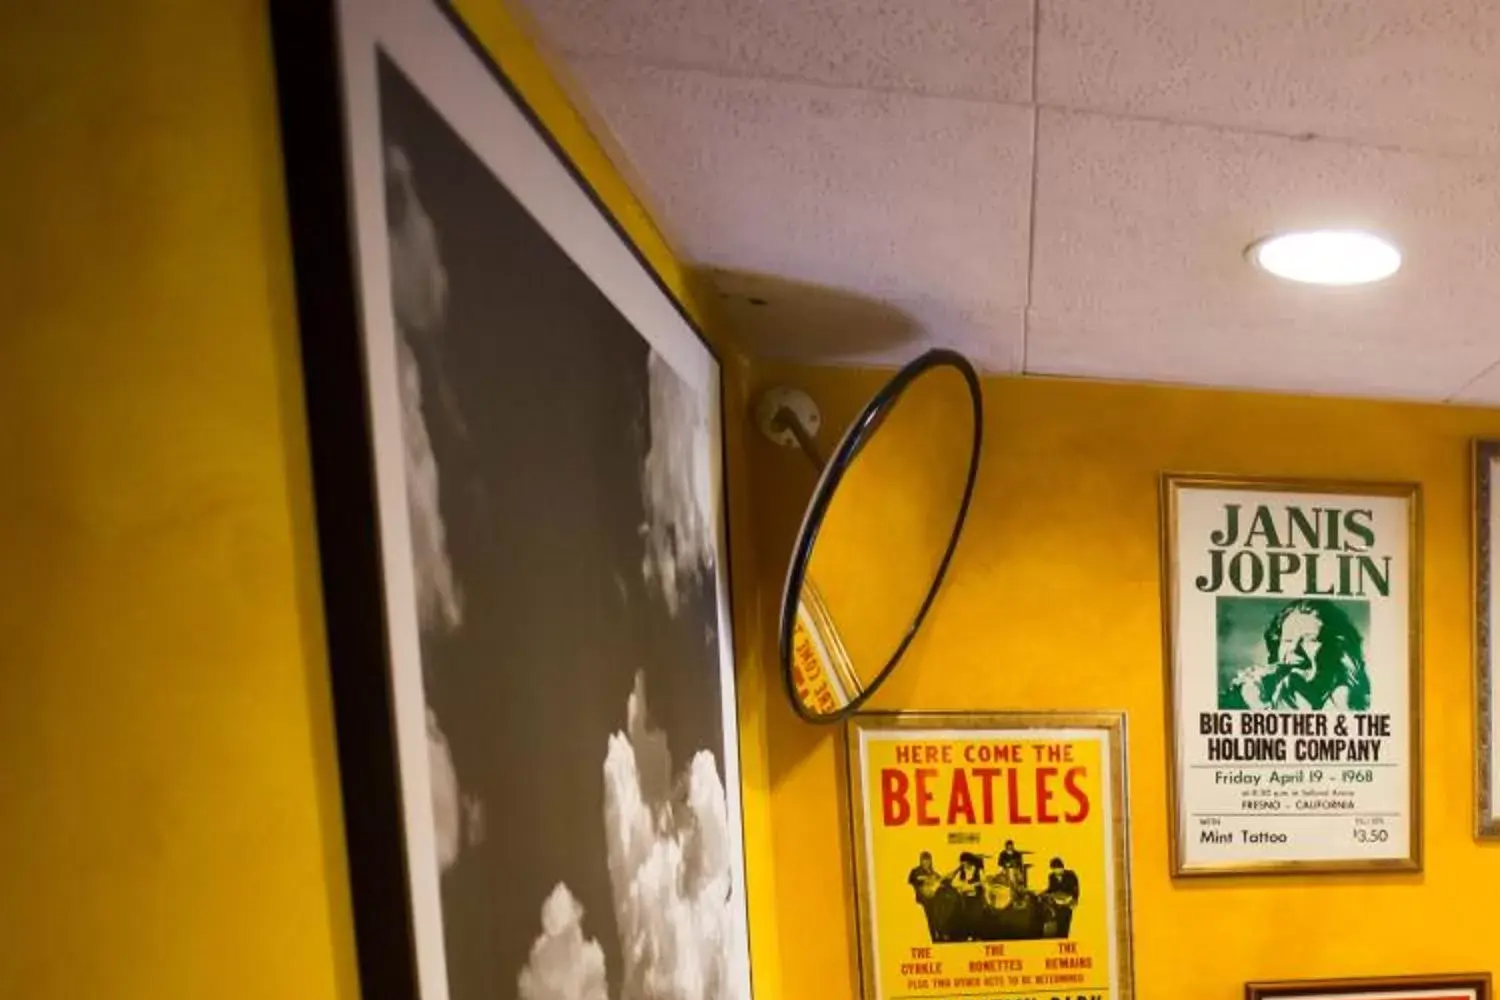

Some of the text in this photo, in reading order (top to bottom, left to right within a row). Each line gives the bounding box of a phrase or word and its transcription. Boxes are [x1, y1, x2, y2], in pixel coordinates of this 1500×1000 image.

[1210, 503, 1376, 553] JANIS
[1195, 549, 1392, 597] JOPLIN
[1200, 713, 1391, 737] BIG BROTHER & THE
[895, 744, 1075, 764] HERE COME THE
[1208, 738, 1382, 762] HOLDING COMPANY
[1215, 769, 1374, 786] Friday April 19 1968
[881, 767, 1091, 827] BEATLES
[1241, 800, 1355, 810] FRESNO CALIFORNIA
[1200, 829, 1233, 843] Mint
[1242, 830, 1288, 844] Tattoo
